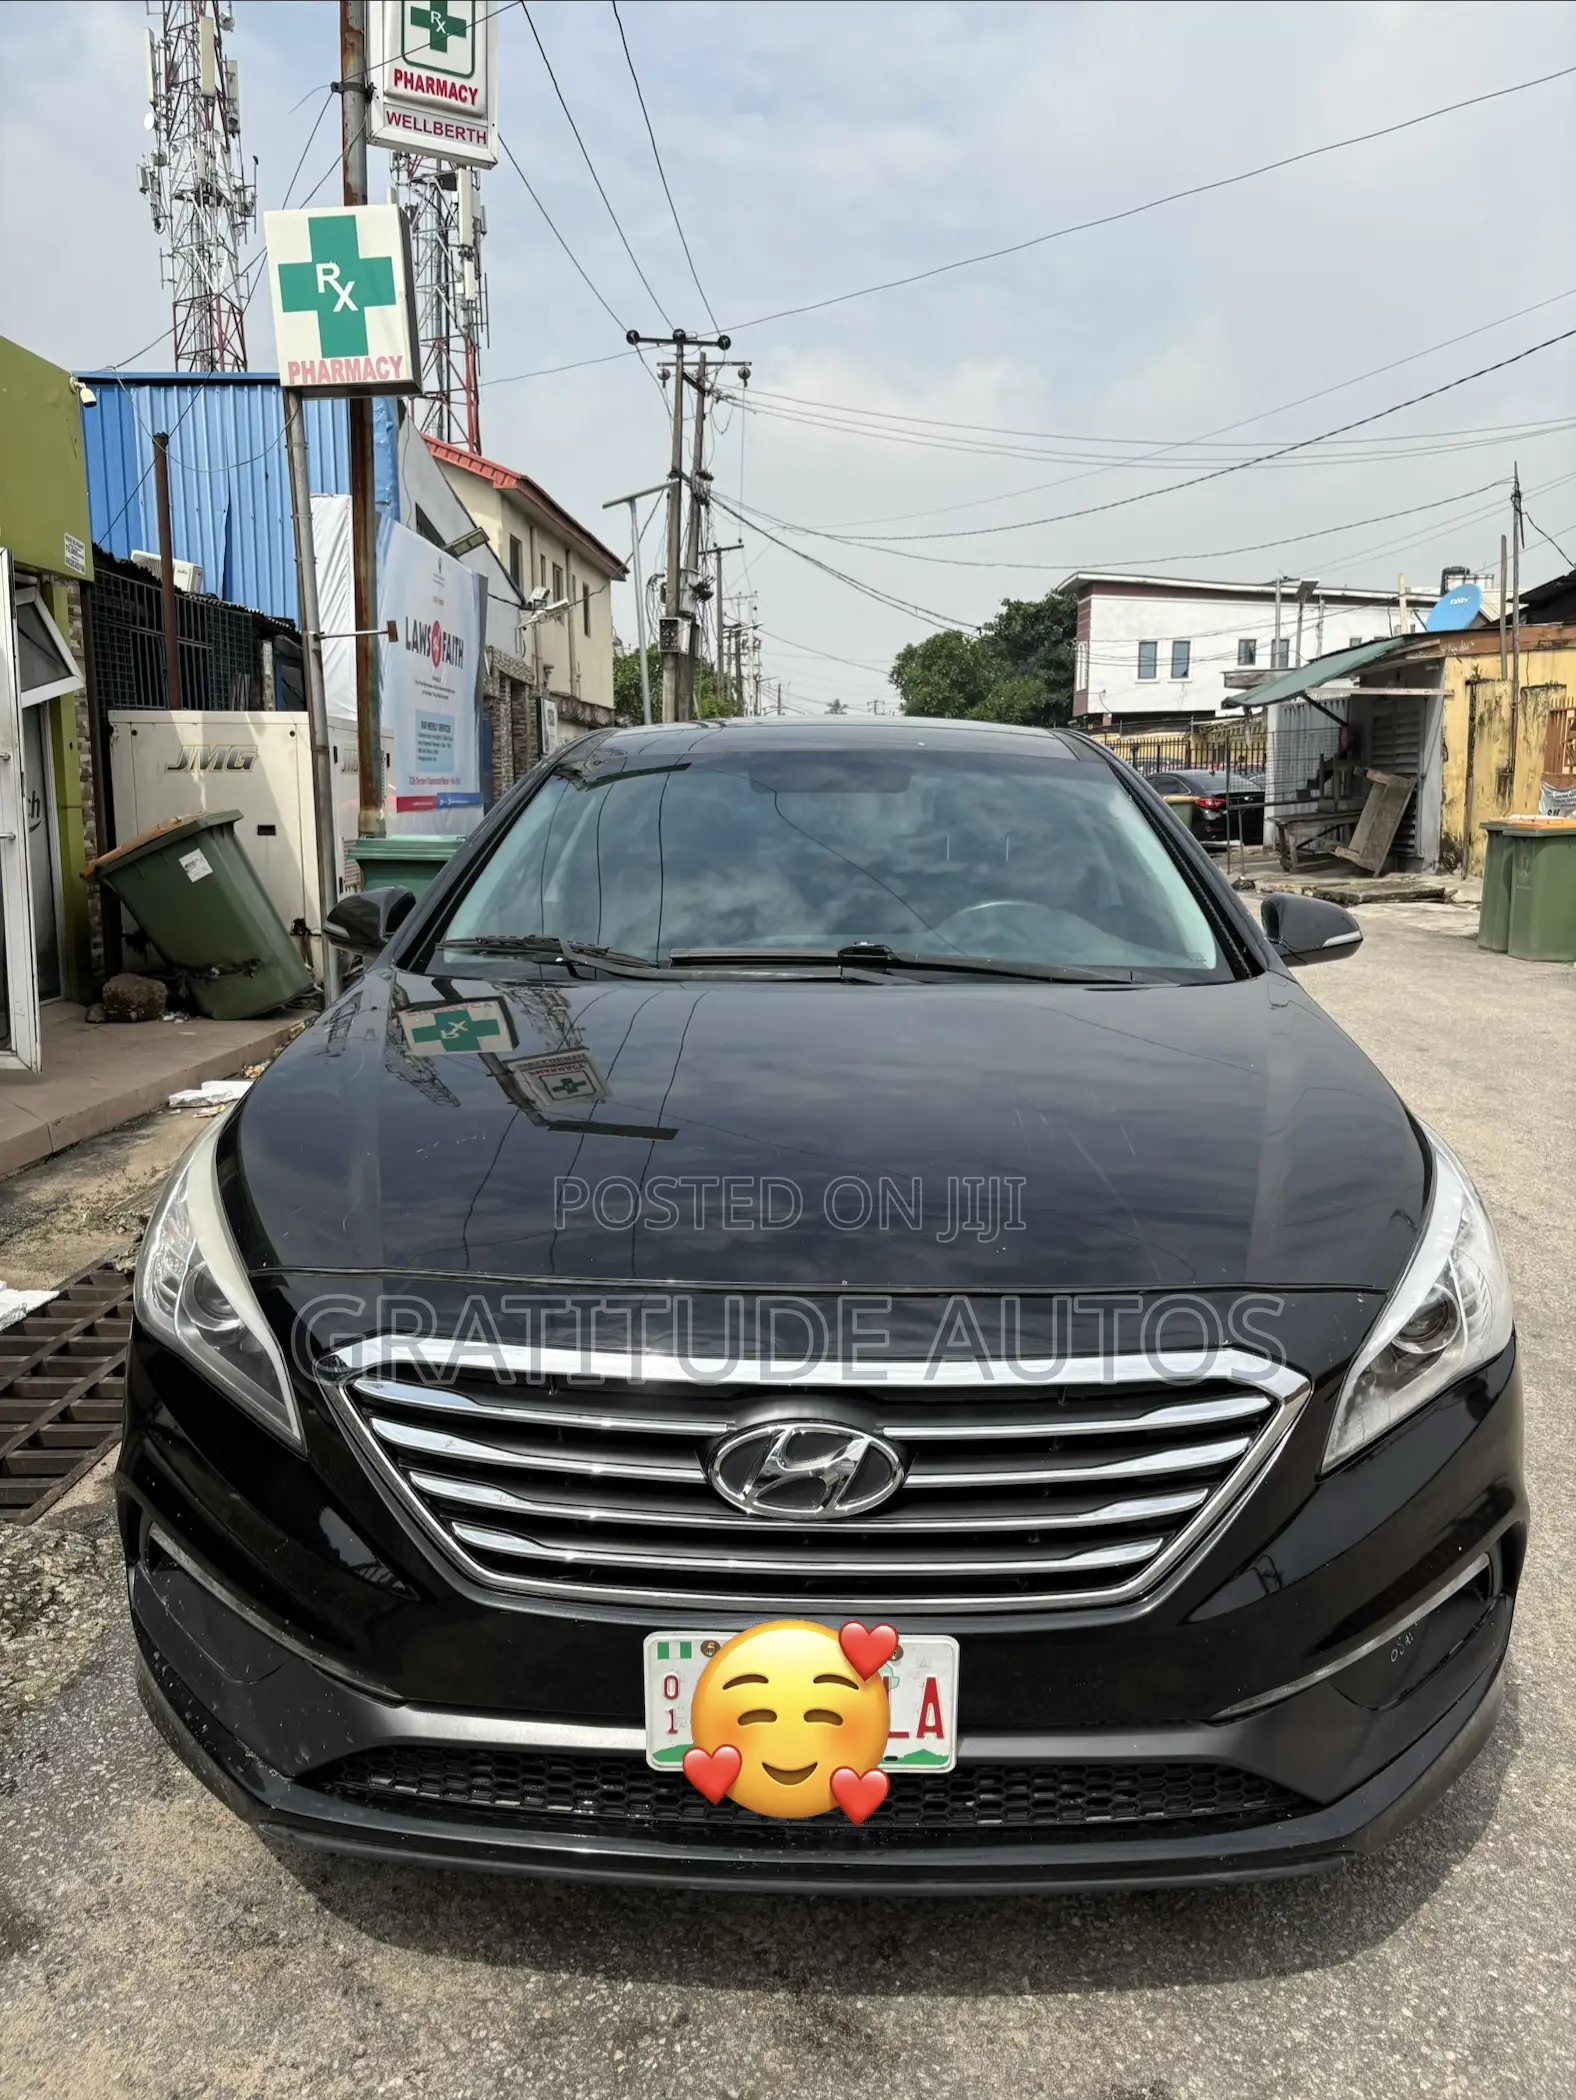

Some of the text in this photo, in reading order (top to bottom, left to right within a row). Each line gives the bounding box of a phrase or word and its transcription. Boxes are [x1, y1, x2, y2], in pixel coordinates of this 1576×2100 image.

[393, 67, 479, 106] PHARMACY
[386, 110, 487, 145] WELLBERTH
[287, 355, 403, 385] PHARMACY
[405, 615, 431, 658] LAWS
[442, 631, 464, 669] FAITH
[164, 744, 258, 773] JMG
